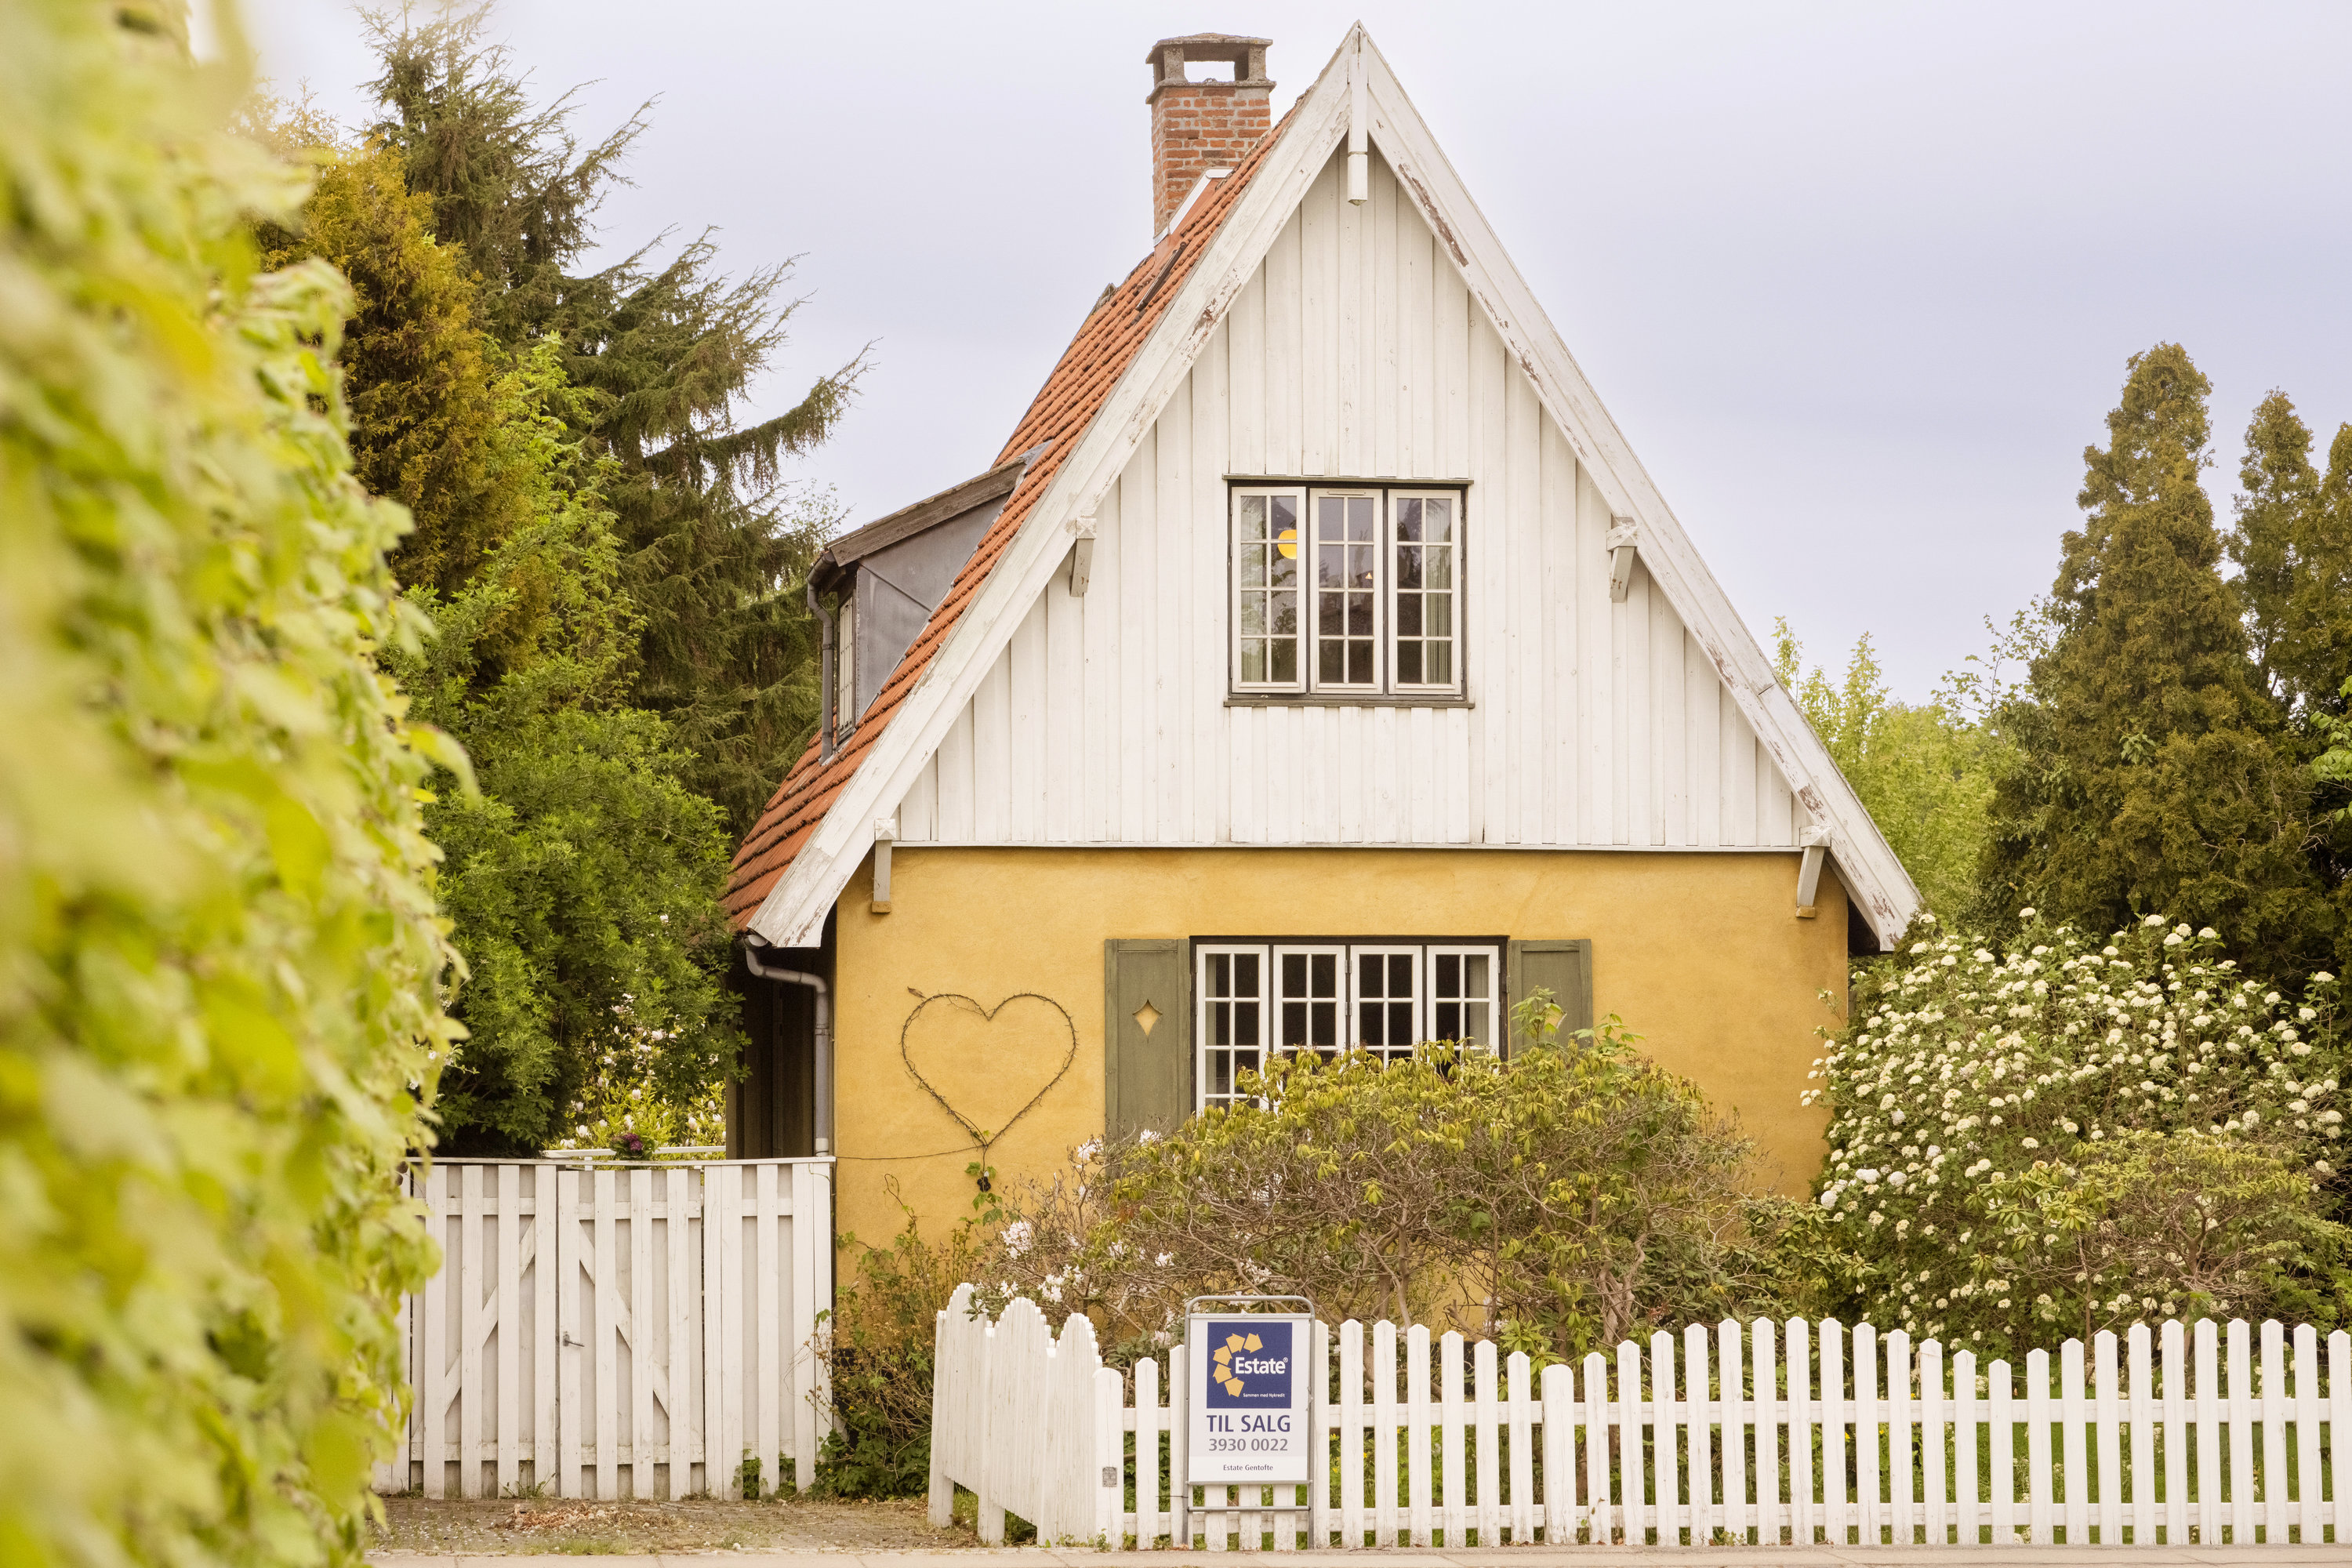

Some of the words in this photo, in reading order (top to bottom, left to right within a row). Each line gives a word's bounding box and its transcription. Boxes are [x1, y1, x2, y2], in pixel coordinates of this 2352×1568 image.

[1206, 1415, 1234, 1432] TIL
[1241, 1414, 1290, 1432] SALG
[1208, 1438, 1247, 1452] 3930
[1250, 1438, 1288, 1452] 0022
